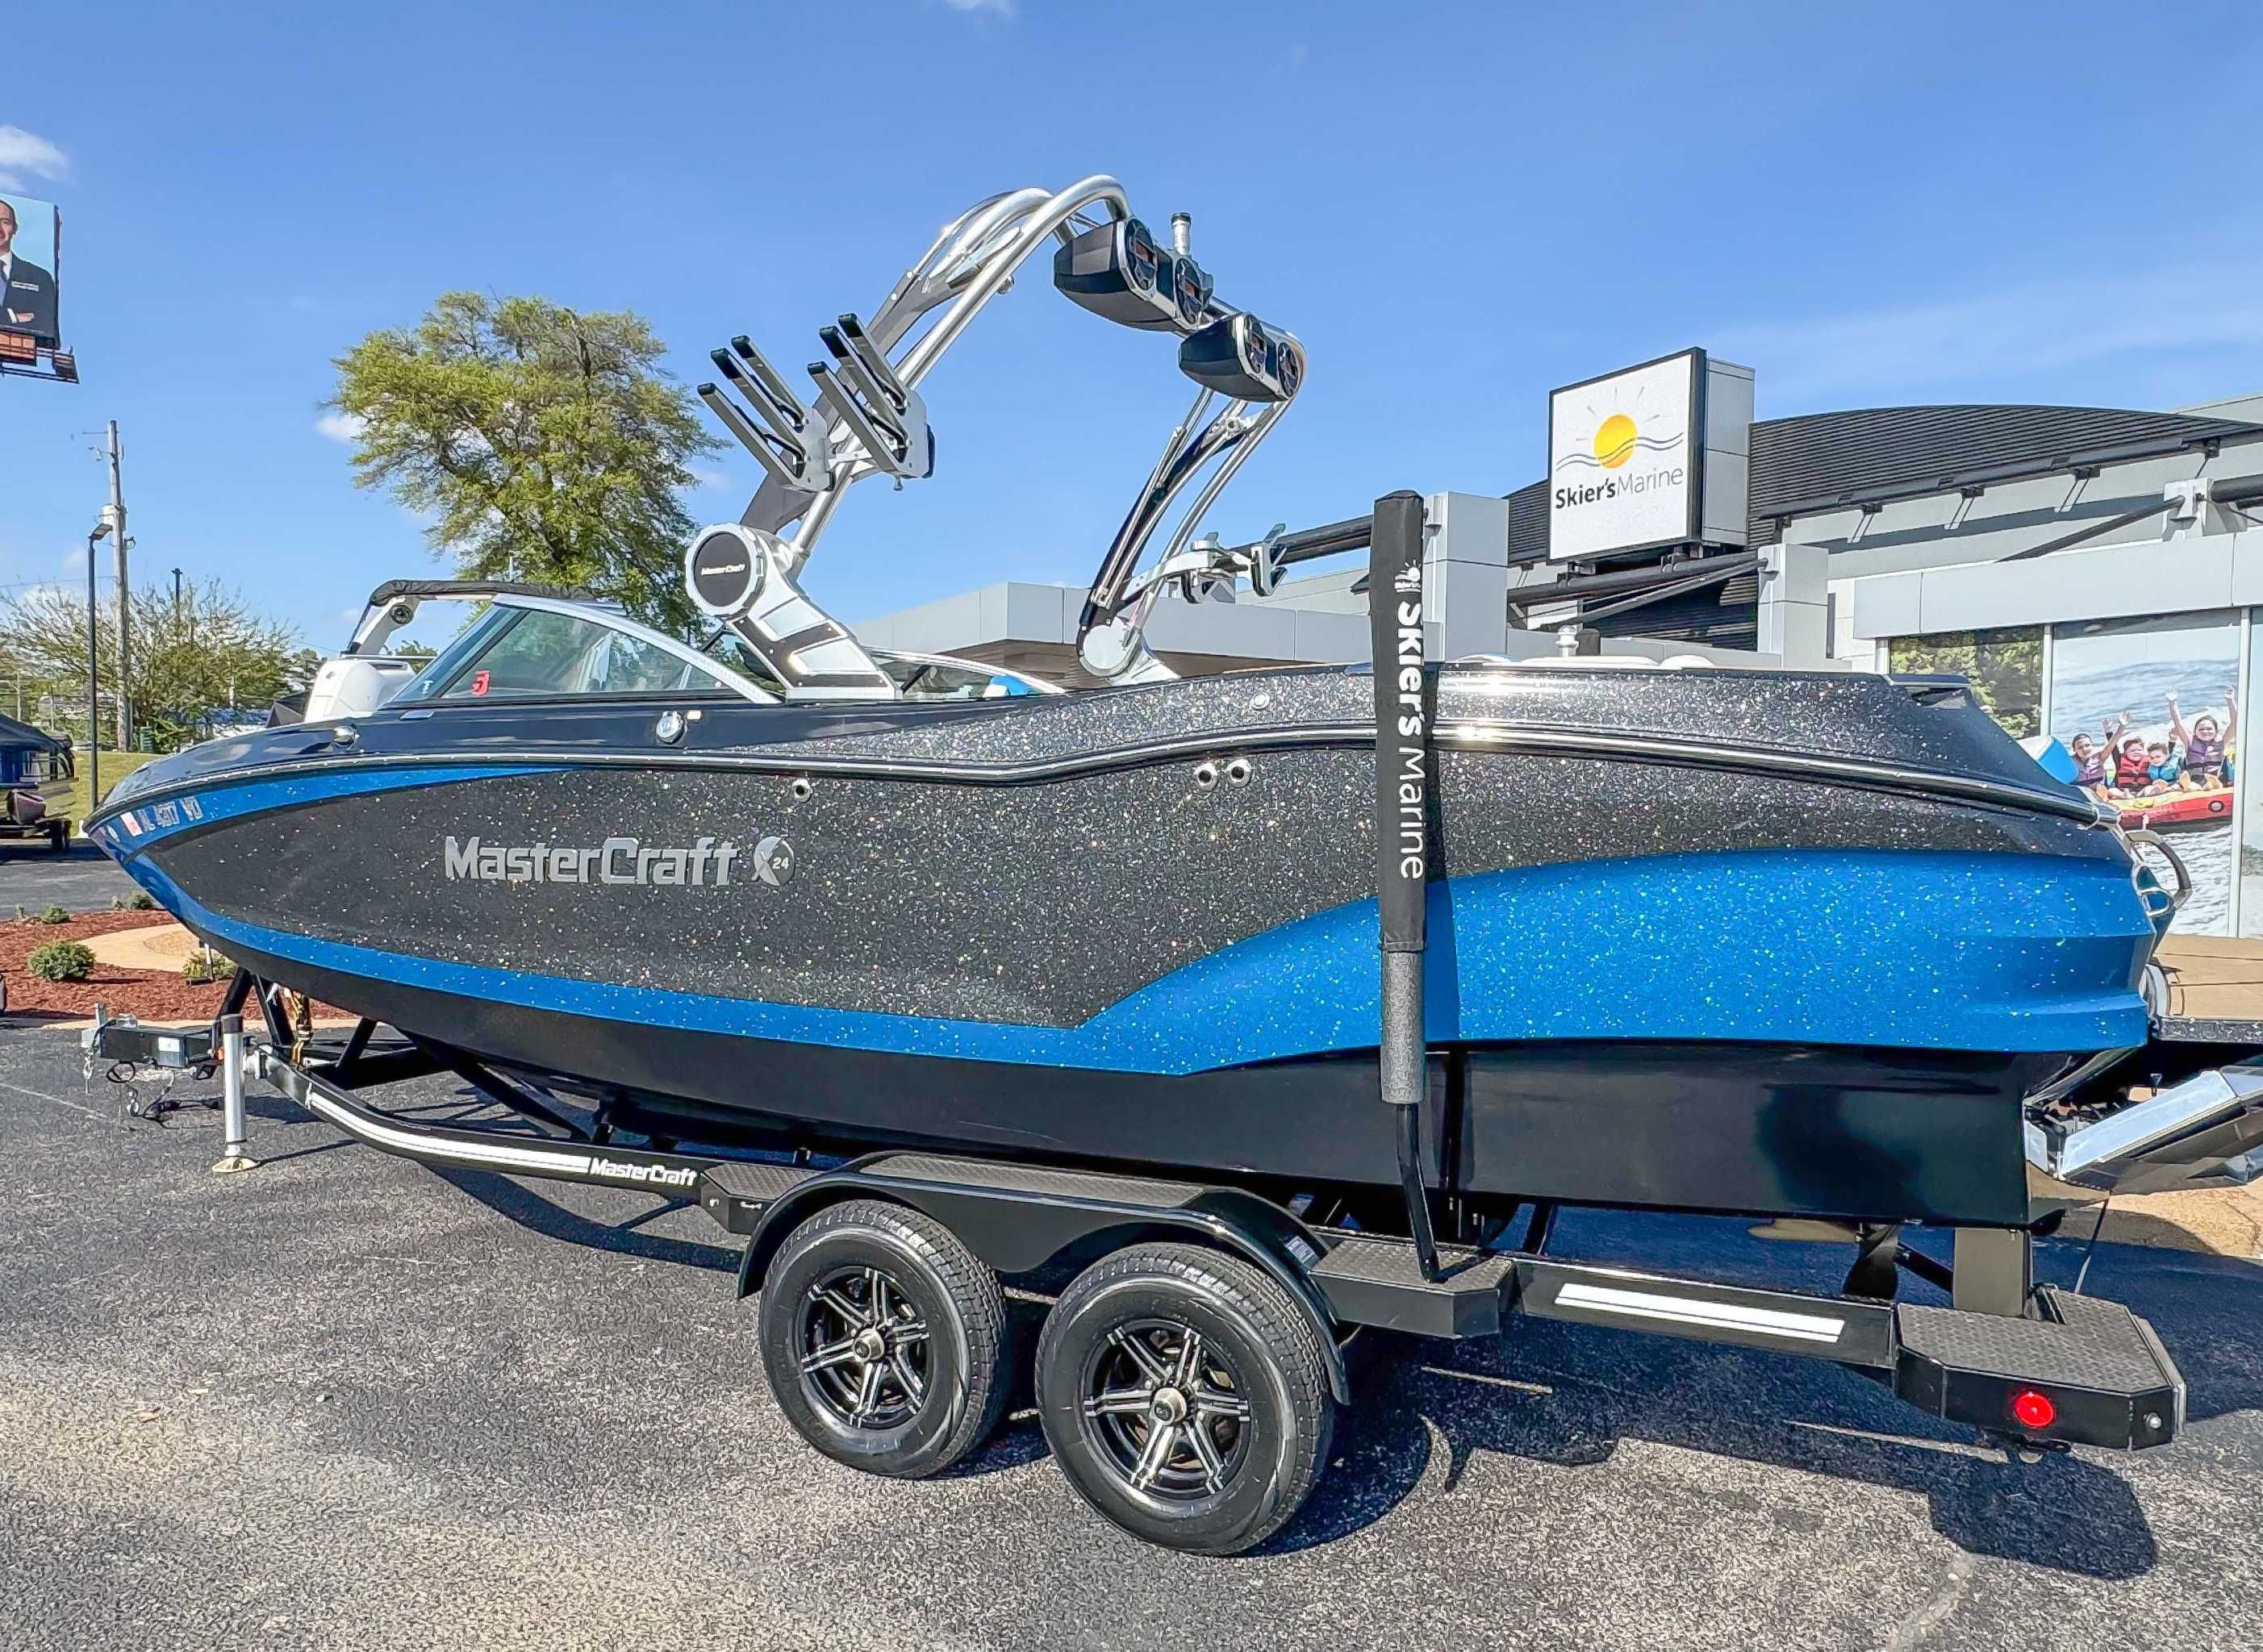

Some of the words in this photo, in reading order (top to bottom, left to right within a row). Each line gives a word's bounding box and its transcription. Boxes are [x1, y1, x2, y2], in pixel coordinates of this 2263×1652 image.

[1397, 601, 1426, 736] Skier's
[1397, 747, 1427, 880] Marine
[445, 836, 737, 886] MasterCraft
[590, 1158, 697, 1186] MasterCraft
